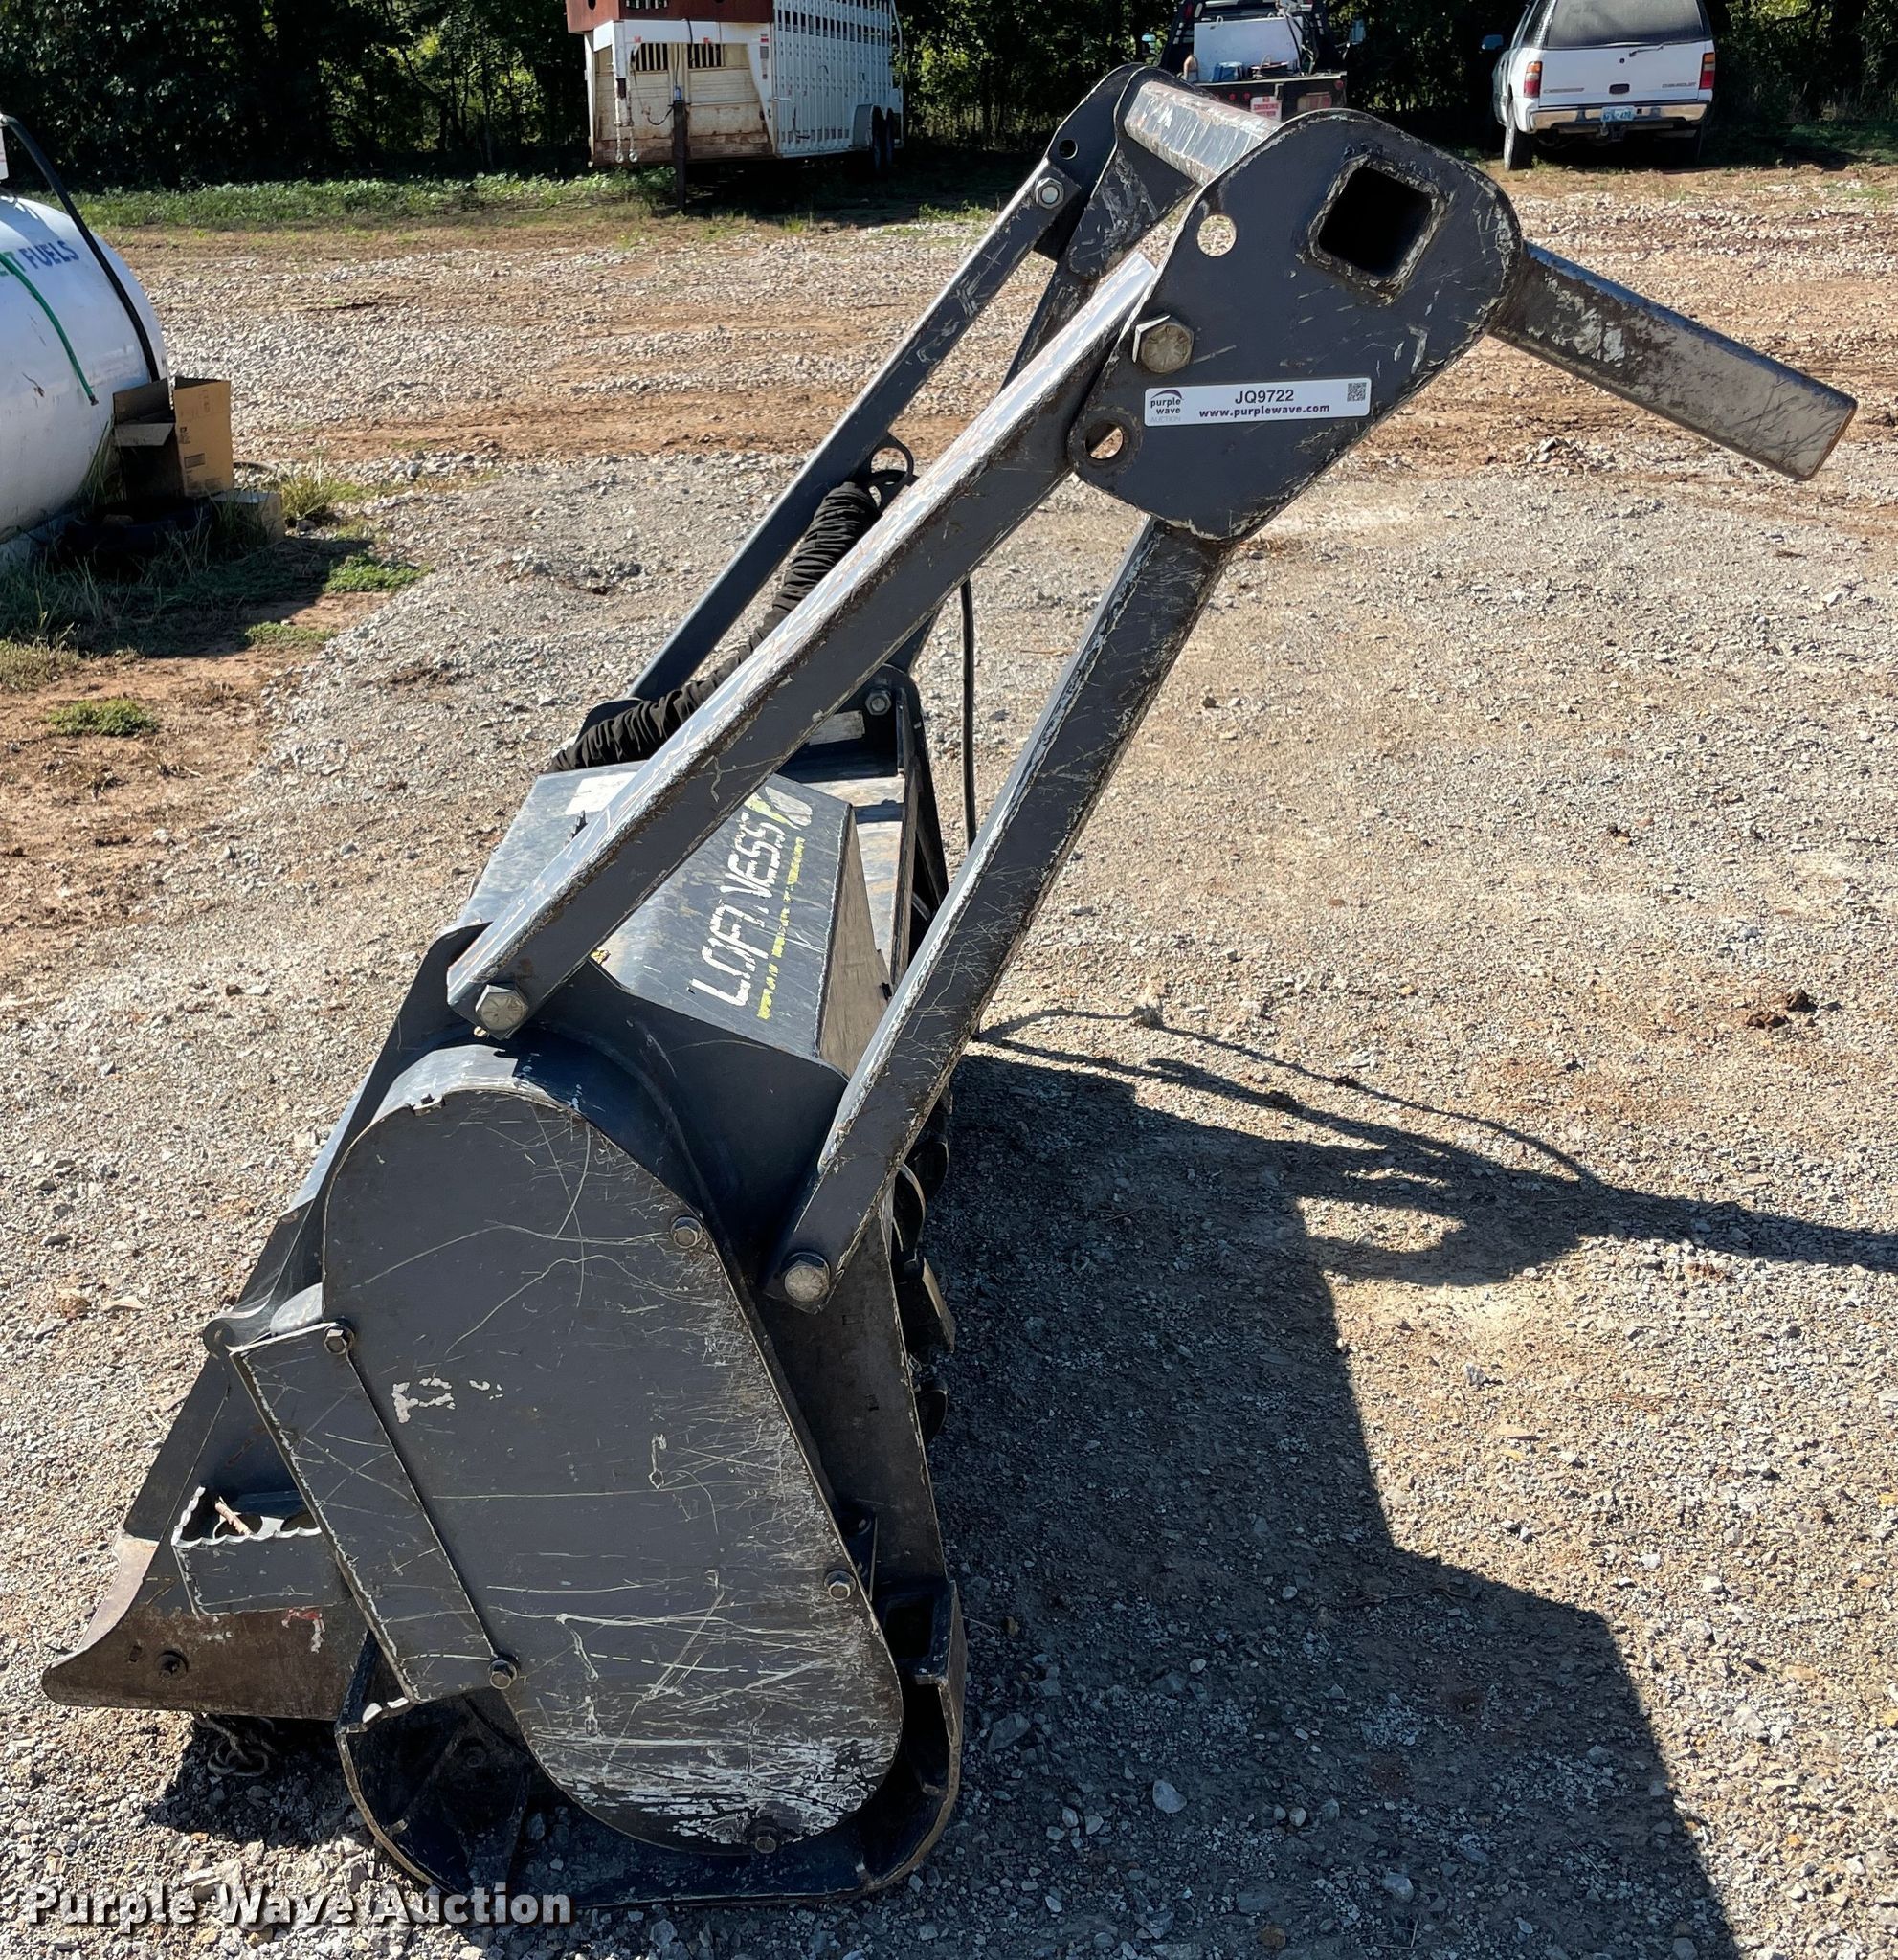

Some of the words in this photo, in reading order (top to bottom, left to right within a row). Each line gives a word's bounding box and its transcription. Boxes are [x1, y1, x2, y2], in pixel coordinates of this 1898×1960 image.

[18, 240, 79, 269] FUELS
[1150, 398, 1182, 409] purple
[1235, 389, 1294, 405] JQ9722
[1198, 404, 1330, 418] www.purplewave.com
